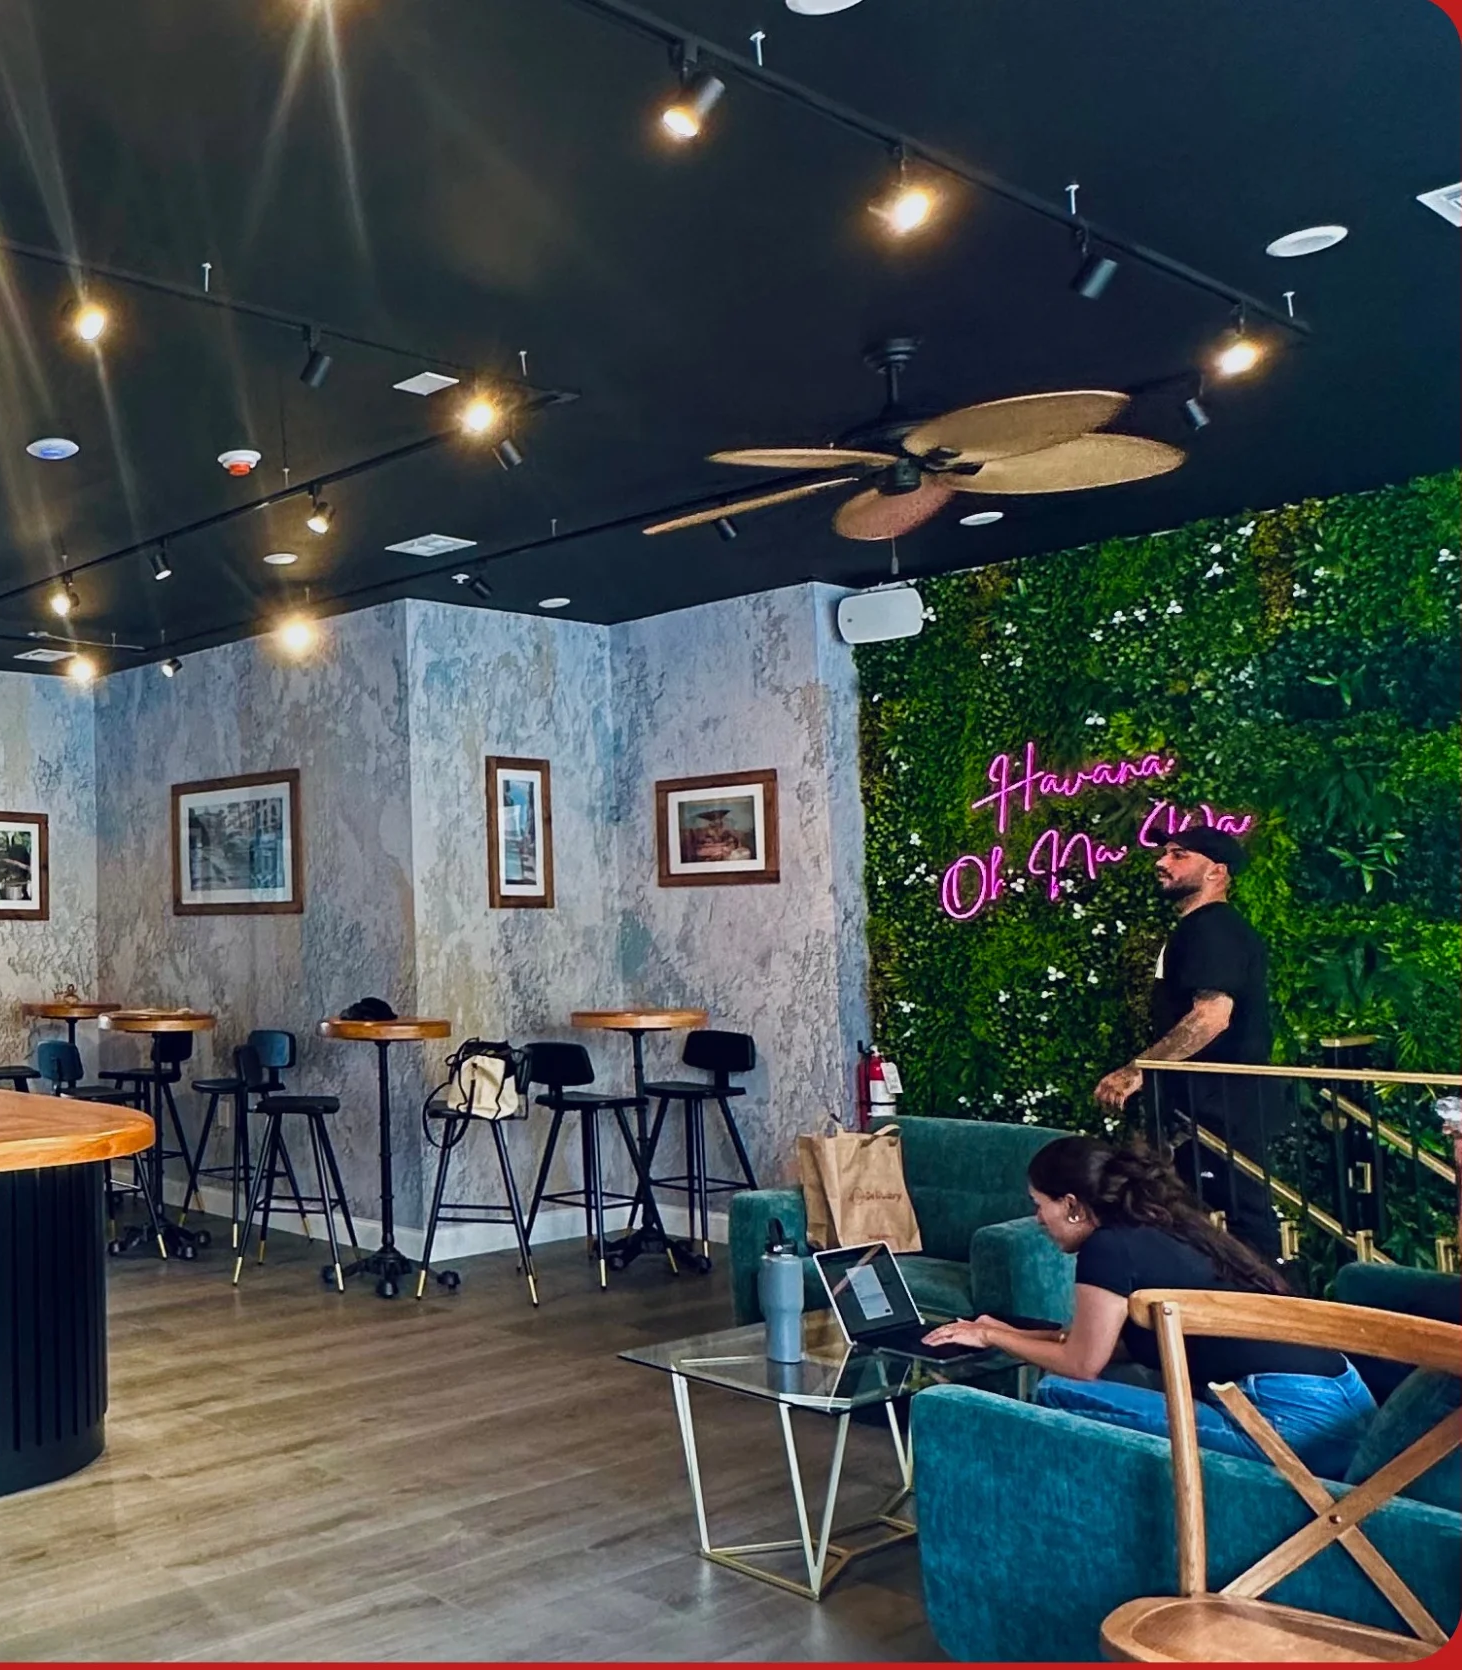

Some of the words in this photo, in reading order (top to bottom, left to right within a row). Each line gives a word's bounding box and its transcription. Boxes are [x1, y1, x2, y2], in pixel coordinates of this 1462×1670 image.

[971, 741, 1175, 834] Havana
[942, 846, 1007, 919] Oh
[1027, 829, 1128, 900] Na
